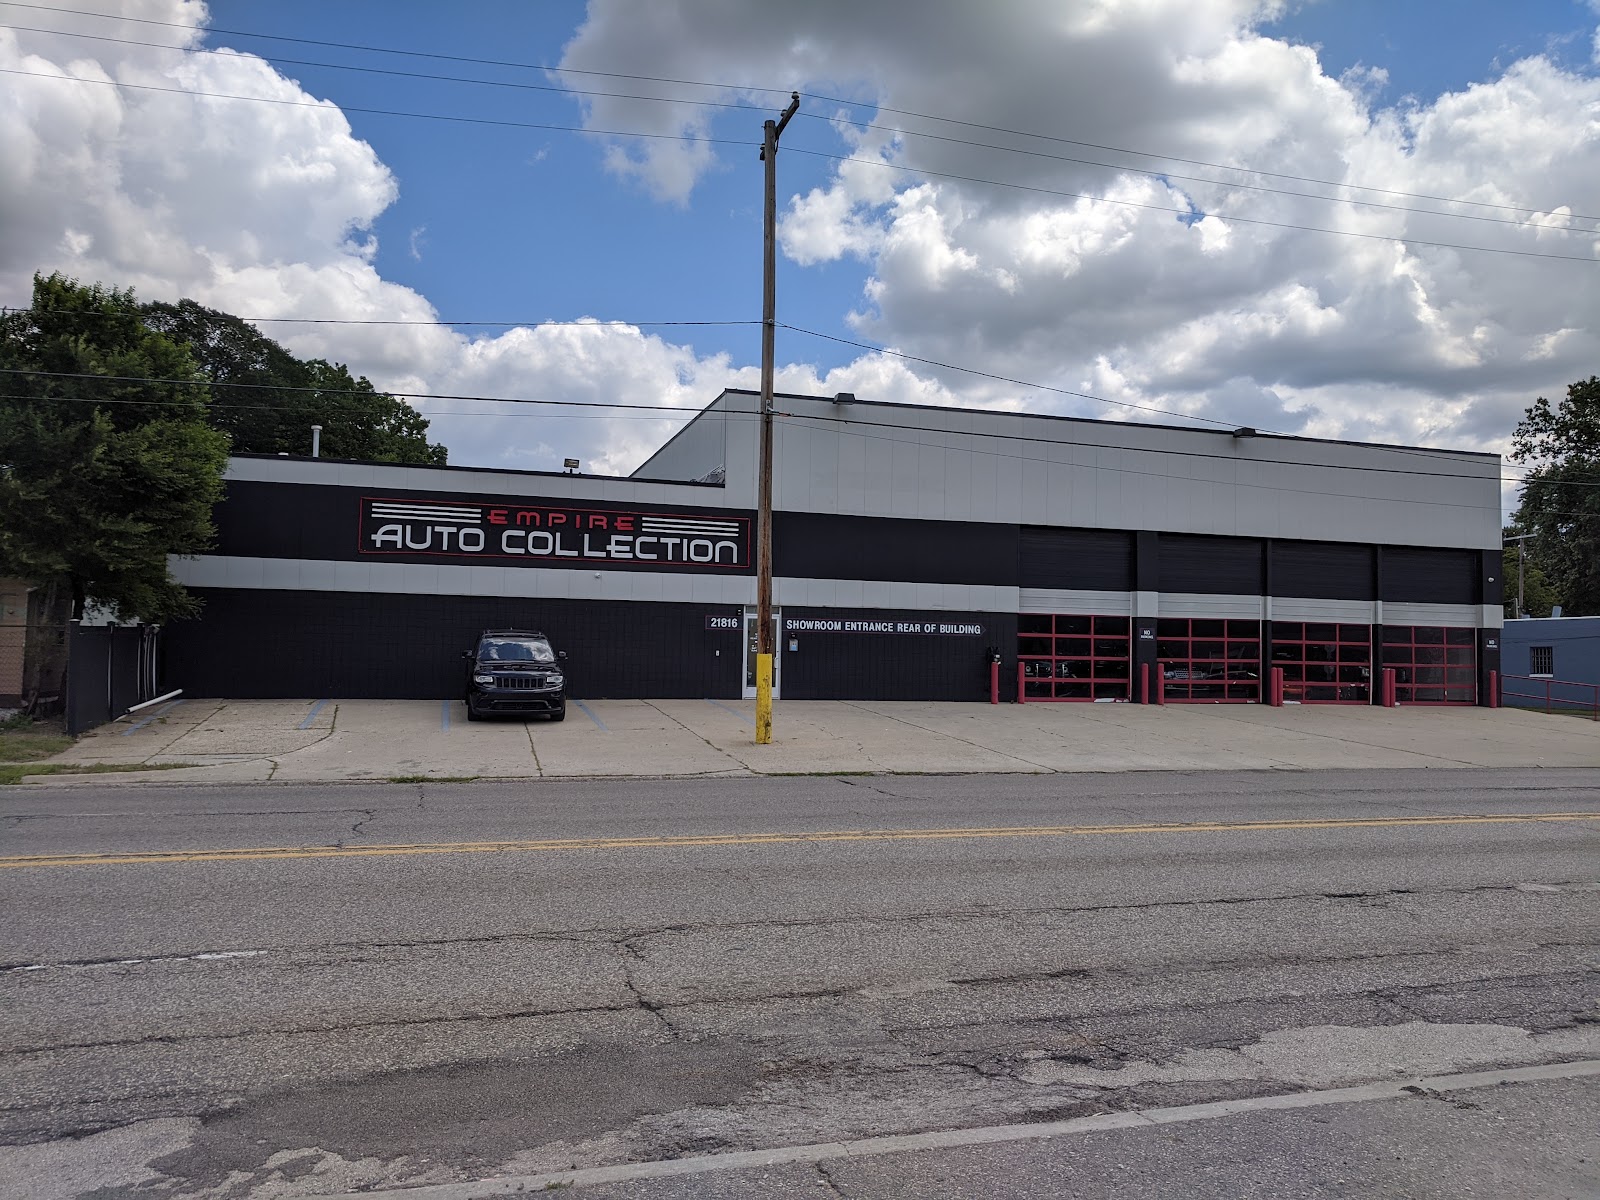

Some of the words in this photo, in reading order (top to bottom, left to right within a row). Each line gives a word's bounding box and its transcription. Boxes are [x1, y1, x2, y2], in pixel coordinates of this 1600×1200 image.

[487, 509, 634, 531] EMPIRE
[371, 525, 484, 552] AUTO
[502, 530, 738, 563] COLLECTION
[710, 617, 738, 628] 21816
[786, 619, 842, 631] SHOWROOM
[845, 621, 893, 633] ENTRANCE
[897, 622, 921, 633] REAR
[924, 623, 937, 633] OF
[939, 624, 981, 635] BUILDING
